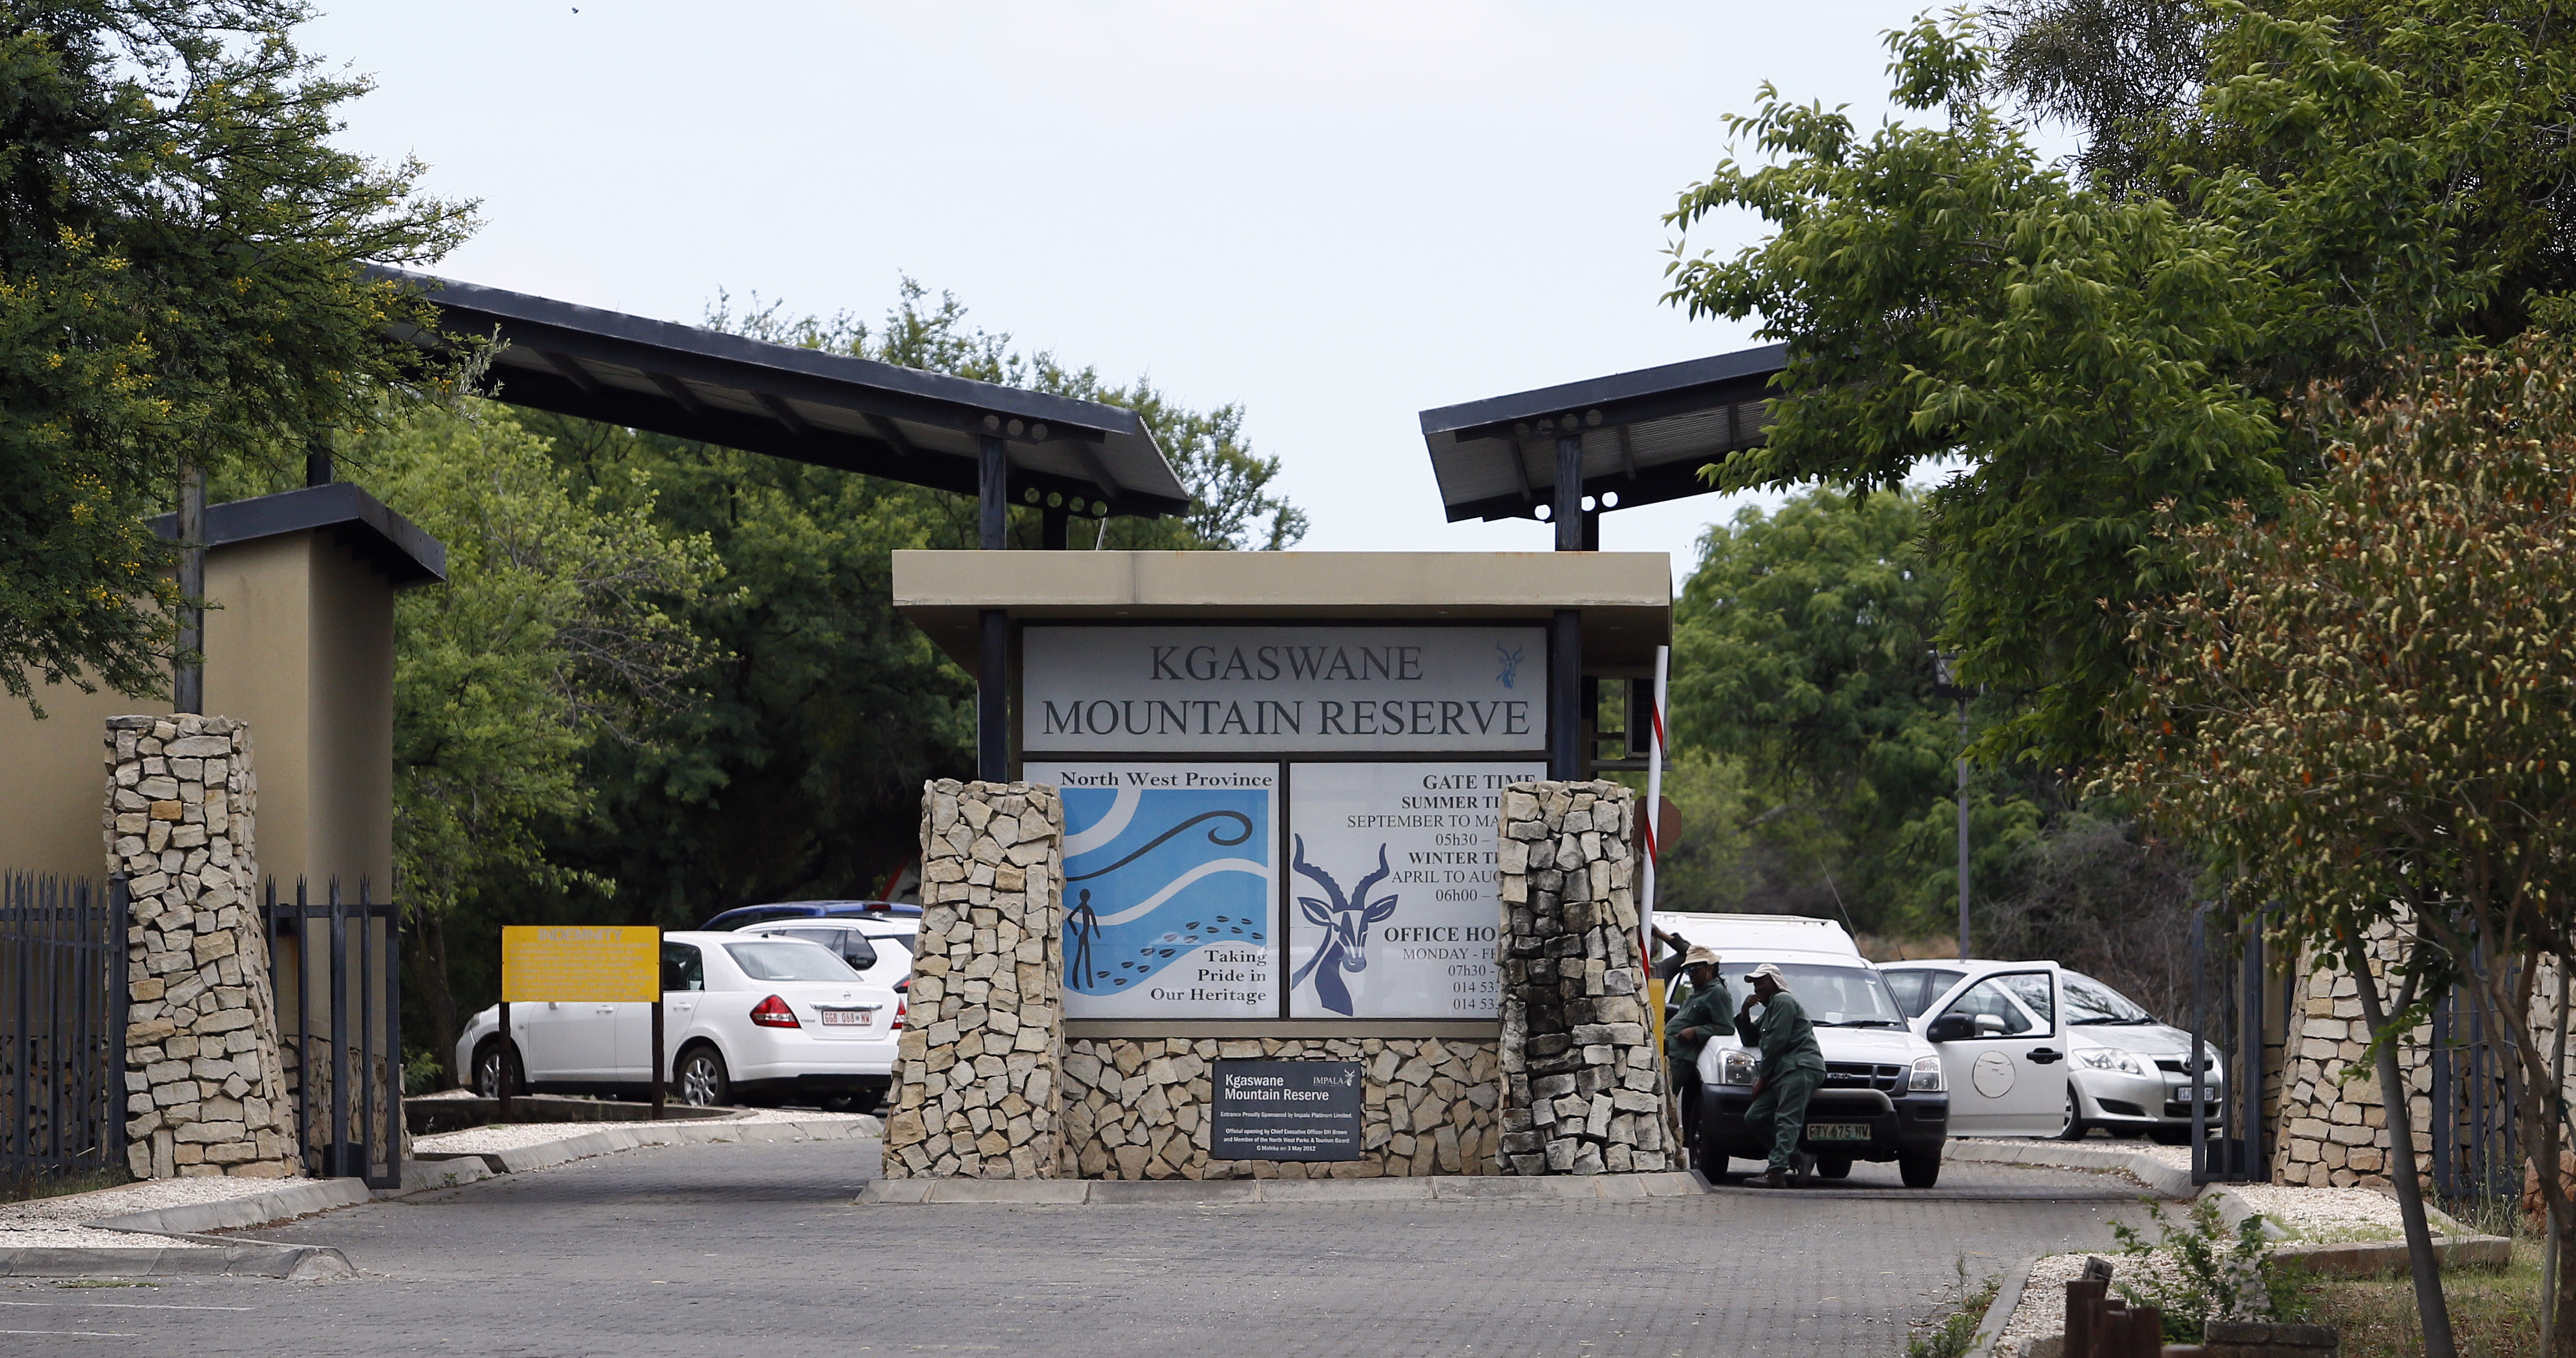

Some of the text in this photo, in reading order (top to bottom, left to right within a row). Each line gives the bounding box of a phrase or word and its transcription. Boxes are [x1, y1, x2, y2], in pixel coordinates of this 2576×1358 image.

[1150, 645, 1423, 681] KGASWANE
[1042, 699, 1530, 735] MOUNTAIN RESERVE
[1060, 772, 1272, 786] North West Province
[1423, 774, 1477, 790] GATE
[1402, 796, 1499, 809] SUMMER TI
[1347, 814, 1443, 828] SEPTEMBER
[1448, 814, 1471, 828] TO
[1435, 832, 1477, 846] 05h30
[1408, 852, 1498, 864] WINTER TI
[1392, 871, 1439, 883] APRIL
[1443, 870, 1465, 883] TO
[1435, 889, 1478, 902] 06h00
[538, 928, 623, 941] INDEMNITY
[1384, 927, 1459, 942] OFFICE
[1205, 950, 1267, 967] Taking
[1403, 948, 1469, 960] MONDAY
[1198, 968, 1266, 982] Pride in
[1448, 964, 1486, 977] 07h30
[1453, 981, 1476, 993] 014
[1150, 988, 1266, 1005] Our Heritage
[1453, 998, 1476, 1010] 014
[842, 1012, 855, 1023] 068
[861, 1012, 870, 1023] NW
[1225, 1074, 1284, 1089] Kgaswane
[1313, 1076, 1343, 1085] IMPALA
[1225, 1089, 1329, 1101] Mountain Reserve
[1809, 1125, 1828, 1138] FTY
[1855, 1125, 1869, 1138] NW
